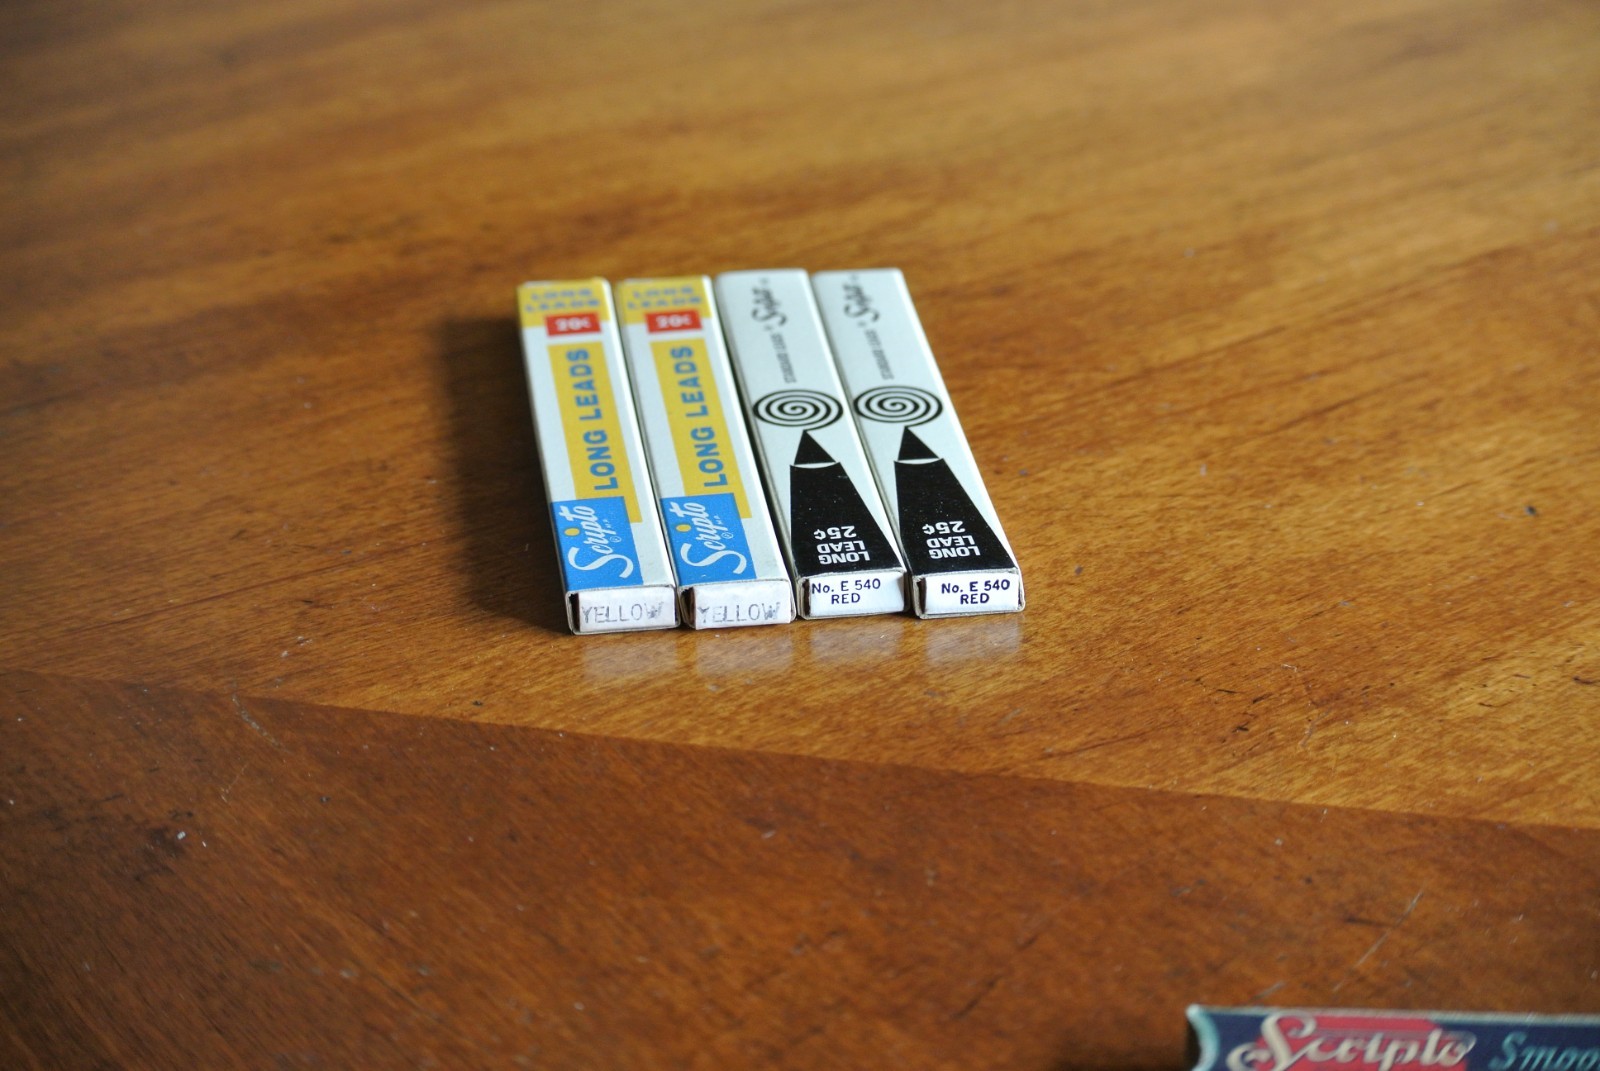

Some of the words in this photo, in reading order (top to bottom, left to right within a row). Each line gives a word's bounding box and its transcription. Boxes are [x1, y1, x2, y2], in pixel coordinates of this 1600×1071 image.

[566, 348, 603, 421] LEADS
[670, 346, 709, 418] LEADS
[583, 429, 619, 490] LONG
[690, 426, 729, 487] LONG
[813, 525, 857, 541] 25¢
[922, 520, 966, 536] 25¢
[559, 505, 634, 579] Scripto
[669, 501, 747, 575] Scripto
[926, 535, 976, 548] LEAD
[816, 540, 866, 553] LEAD
[929, 545, 981, 560] LONG
[819, 550, 871, 565] LONG
[811, 582, 834, 594] No.
[840, 580, 849, 592] E
[854, 578, 881, 590] 540
[941, 582, 963, 594] No.
[969, 581, 978, 592] E
[984, 579, 1011, 591] 540
[831, 593, 861, 605] RED
[960, 593, 990, 605] RED
[581, 601, 664, 624] YELLOW
[697, 601, 781, 624] YELLOW
[1226, 1010, 1477, 1071] Scripto
[1489, 1031, 1600, 1071] Smoo
